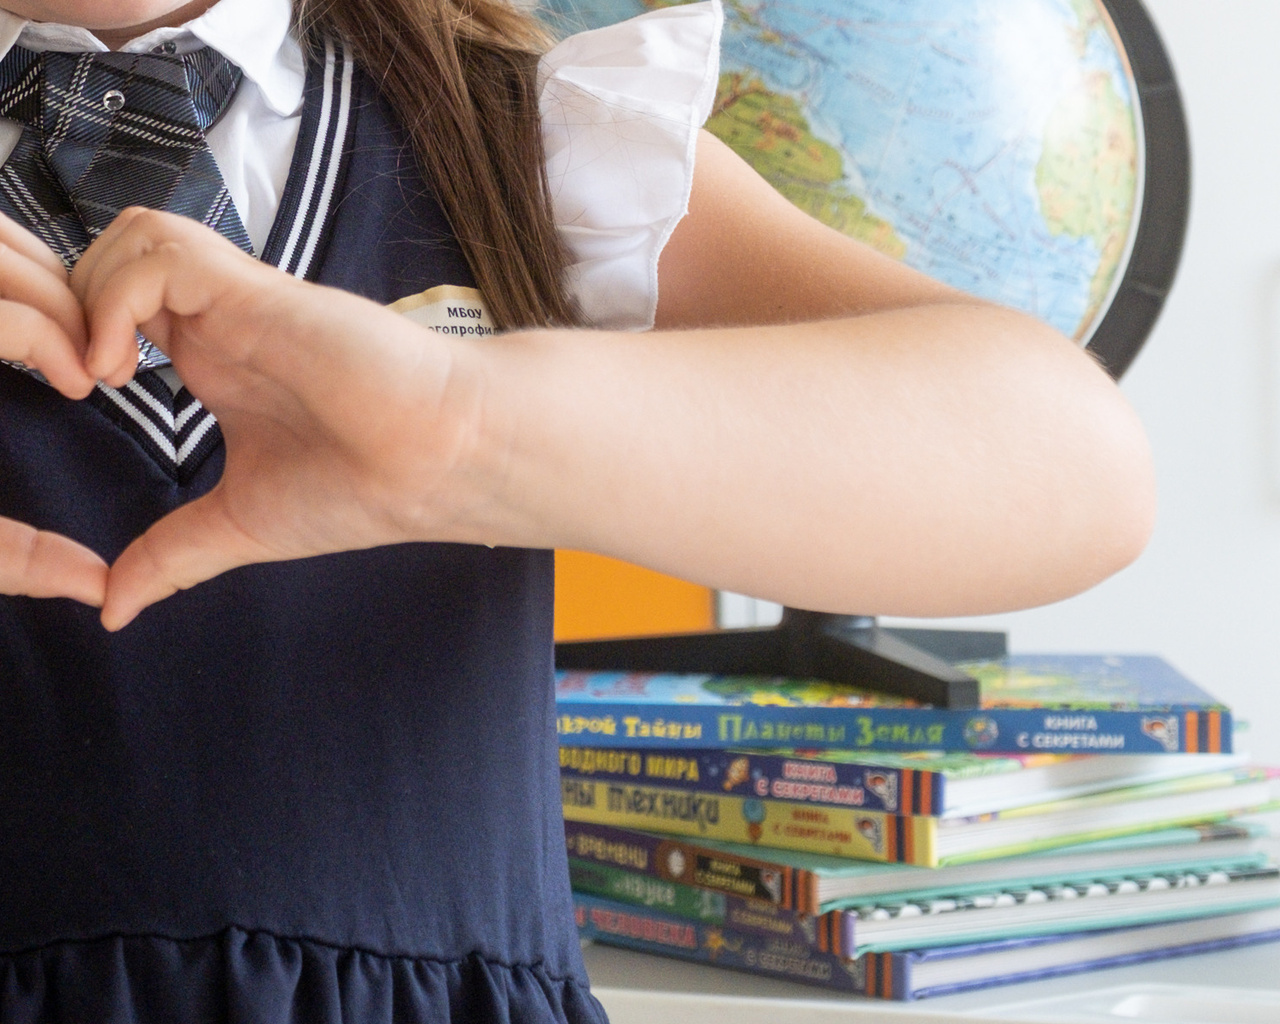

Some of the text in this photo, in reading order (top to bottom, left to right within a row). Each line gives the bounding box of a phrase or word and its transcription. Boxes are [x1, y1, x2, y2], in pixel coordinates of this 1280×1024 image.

[447, 307, 482, 319] МБОУ
[718, 713, 845, 743] Планеты
[855, 716, 947, 746] Земля
[646, 755, 700, 782] МИРА
